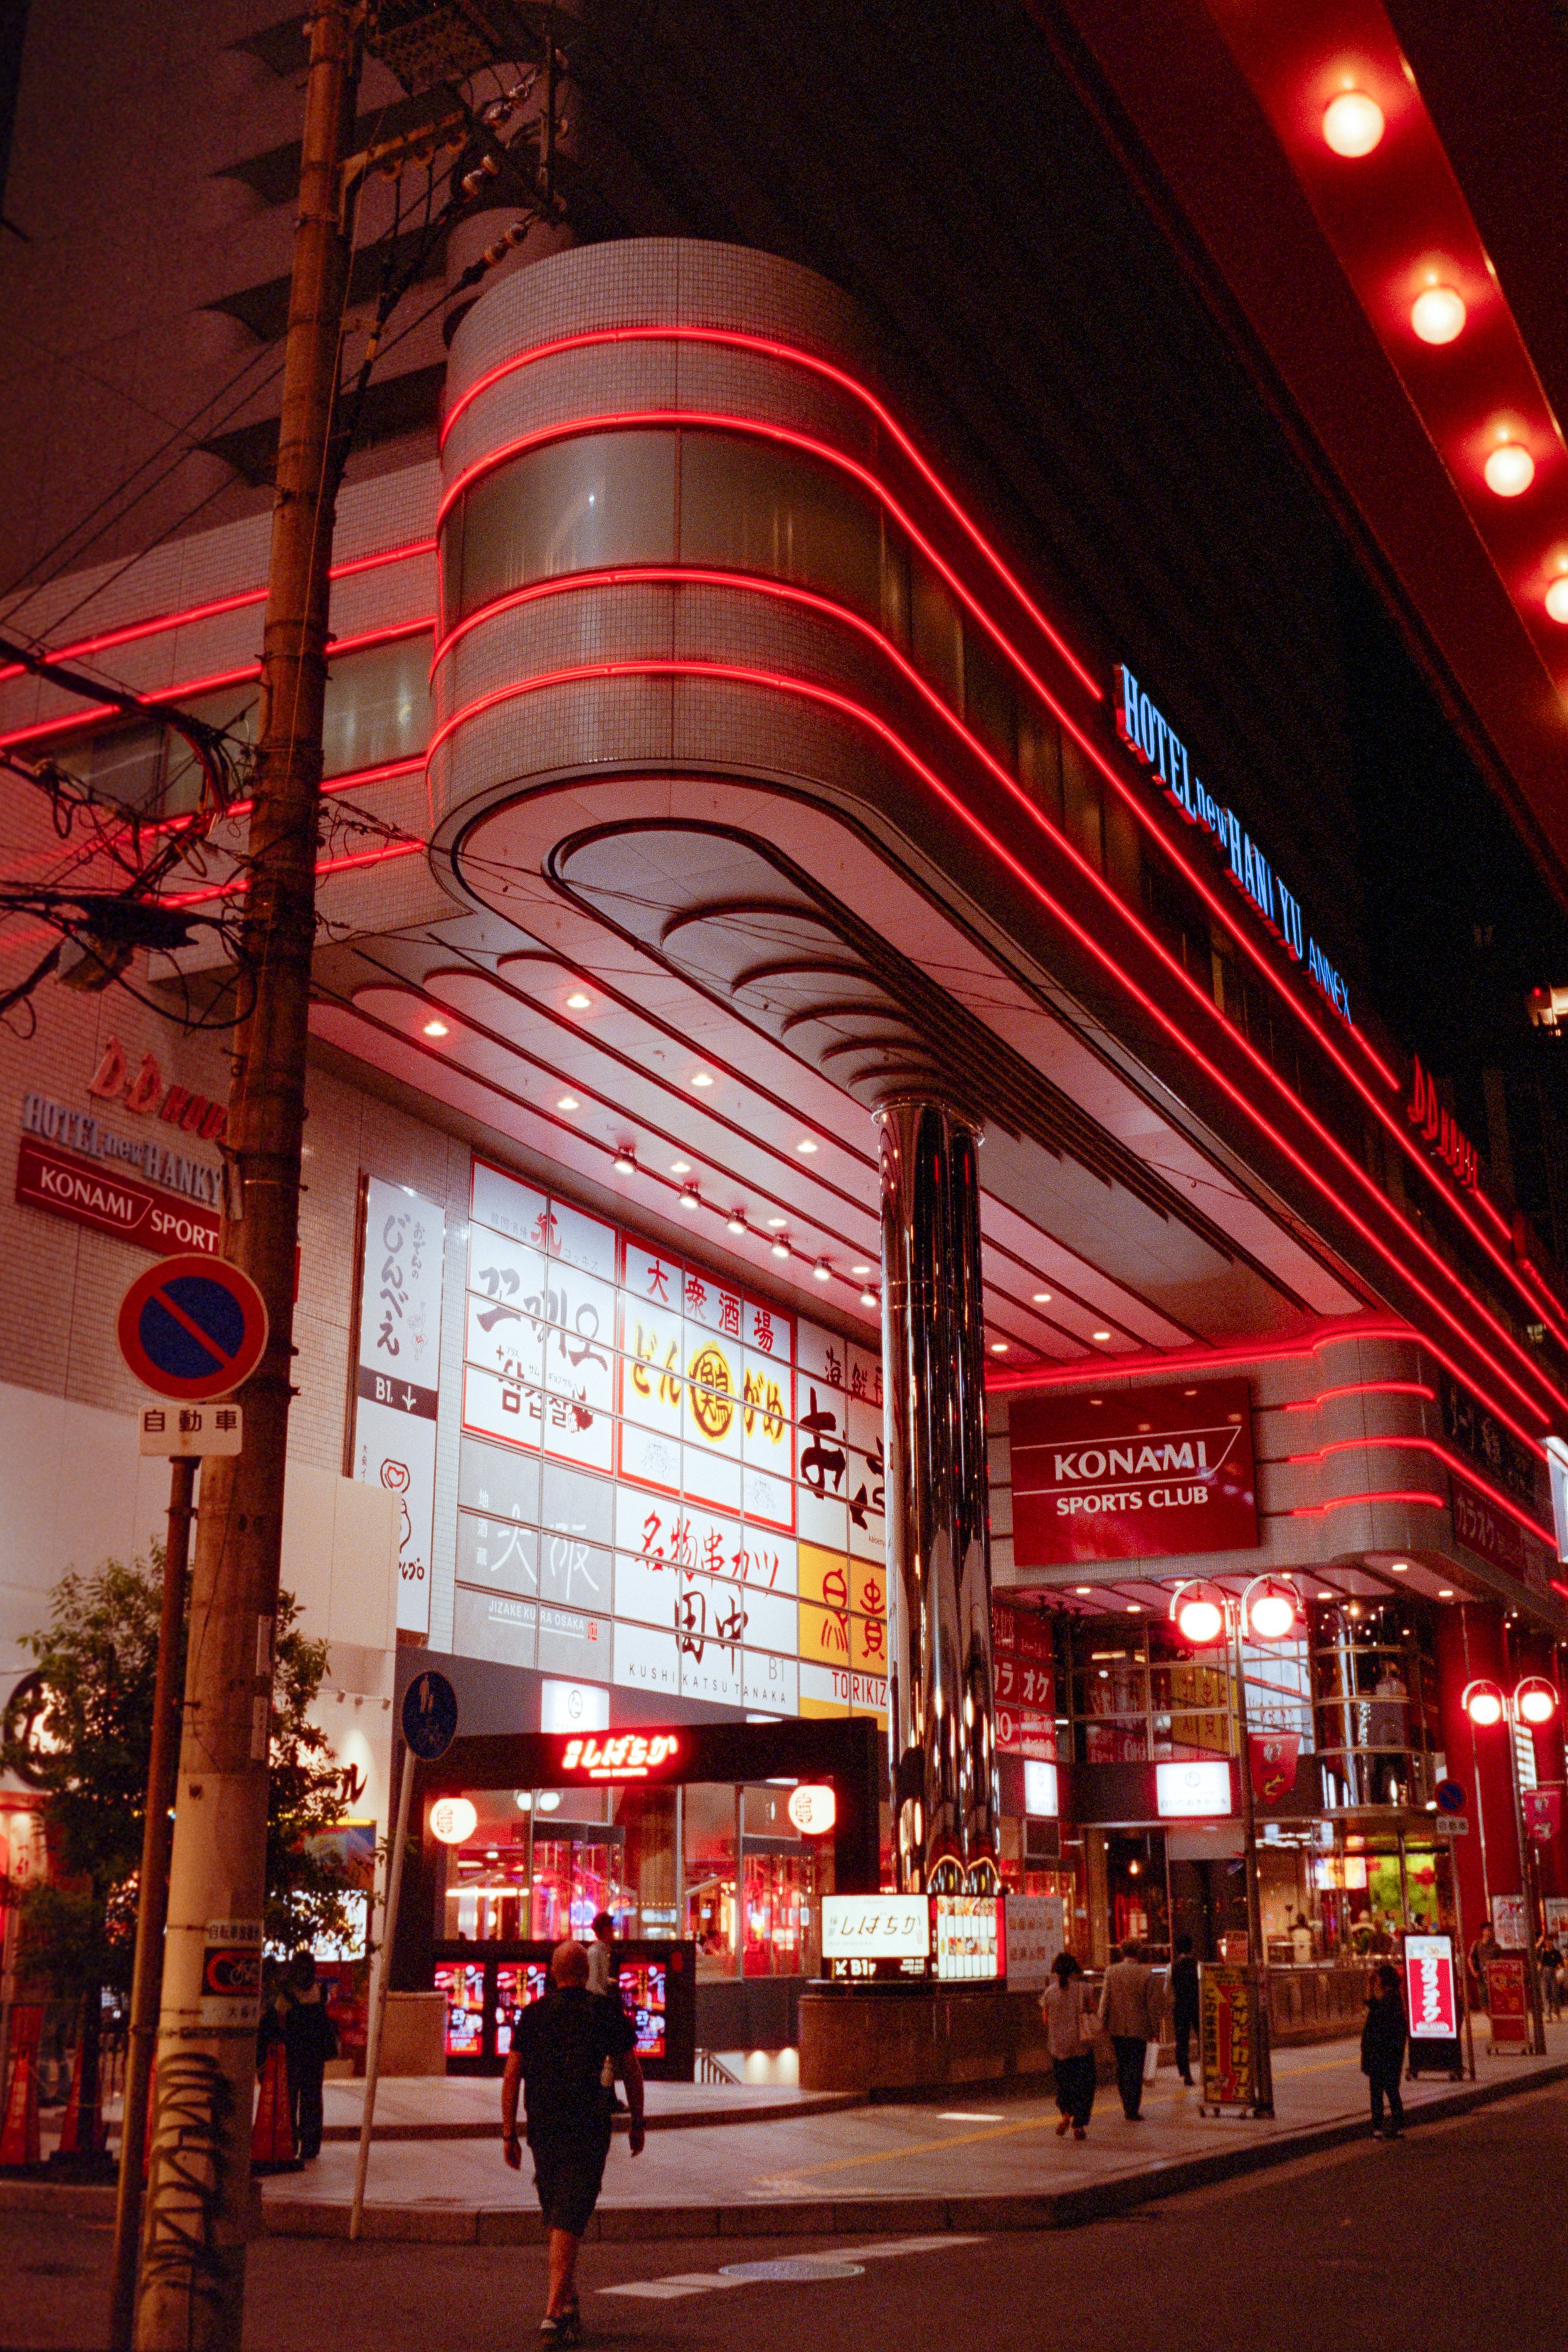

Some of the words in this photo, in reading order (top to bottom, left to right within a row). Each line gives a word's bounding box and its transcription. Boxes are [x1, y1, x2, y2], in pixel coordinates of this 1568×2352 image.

[1122, 664, 1196, 821] HOTEL
[1195, 776, 1227, 849] new
[1309, 935, 1352, 1025] ANNEX
[21, 1091, 104, 1160] HOTEL
[104, 1131, 145, 1167] new
[41, 1166, 133, 1221] KONAMI
[411, 1221, 426, 1279] おでんの
[377, 1213, 411, 1357] じんべえ
[647, 1259, 775, 1353] 大衆酒場
[476, 1266, 608, 1372] 꼬끼오
[144, 1409, 237, 1432] 自動車
[497, 1359, 567, 1429] 삼겹살
[1054, 1441, 1207, 1481] KONAMI
[1056, 1491, 1143, 1516] SPORTS
[1148, 1486, 1209, 1508] CLUB
[491, 1503, 600, 1600] 大阪
[634, 1509, 779, 1598] 名物串カツ
[489, 1600, 523, 1614] JIZAKE
[523, 1607, 552, 1624] KURA
[554, 1614, 585, 1631] OSAKA
[674, 1591, 749, 1676] 田中
[734, 1683, 786, 1703] TANAKA
[769, 1656, 785, 1683] B1
[581, 1734, 679, 1767] しばちか
[840, 1912, 921, 1936] しばちか
[1420, 1958, 1441, 2023] カラオケ
